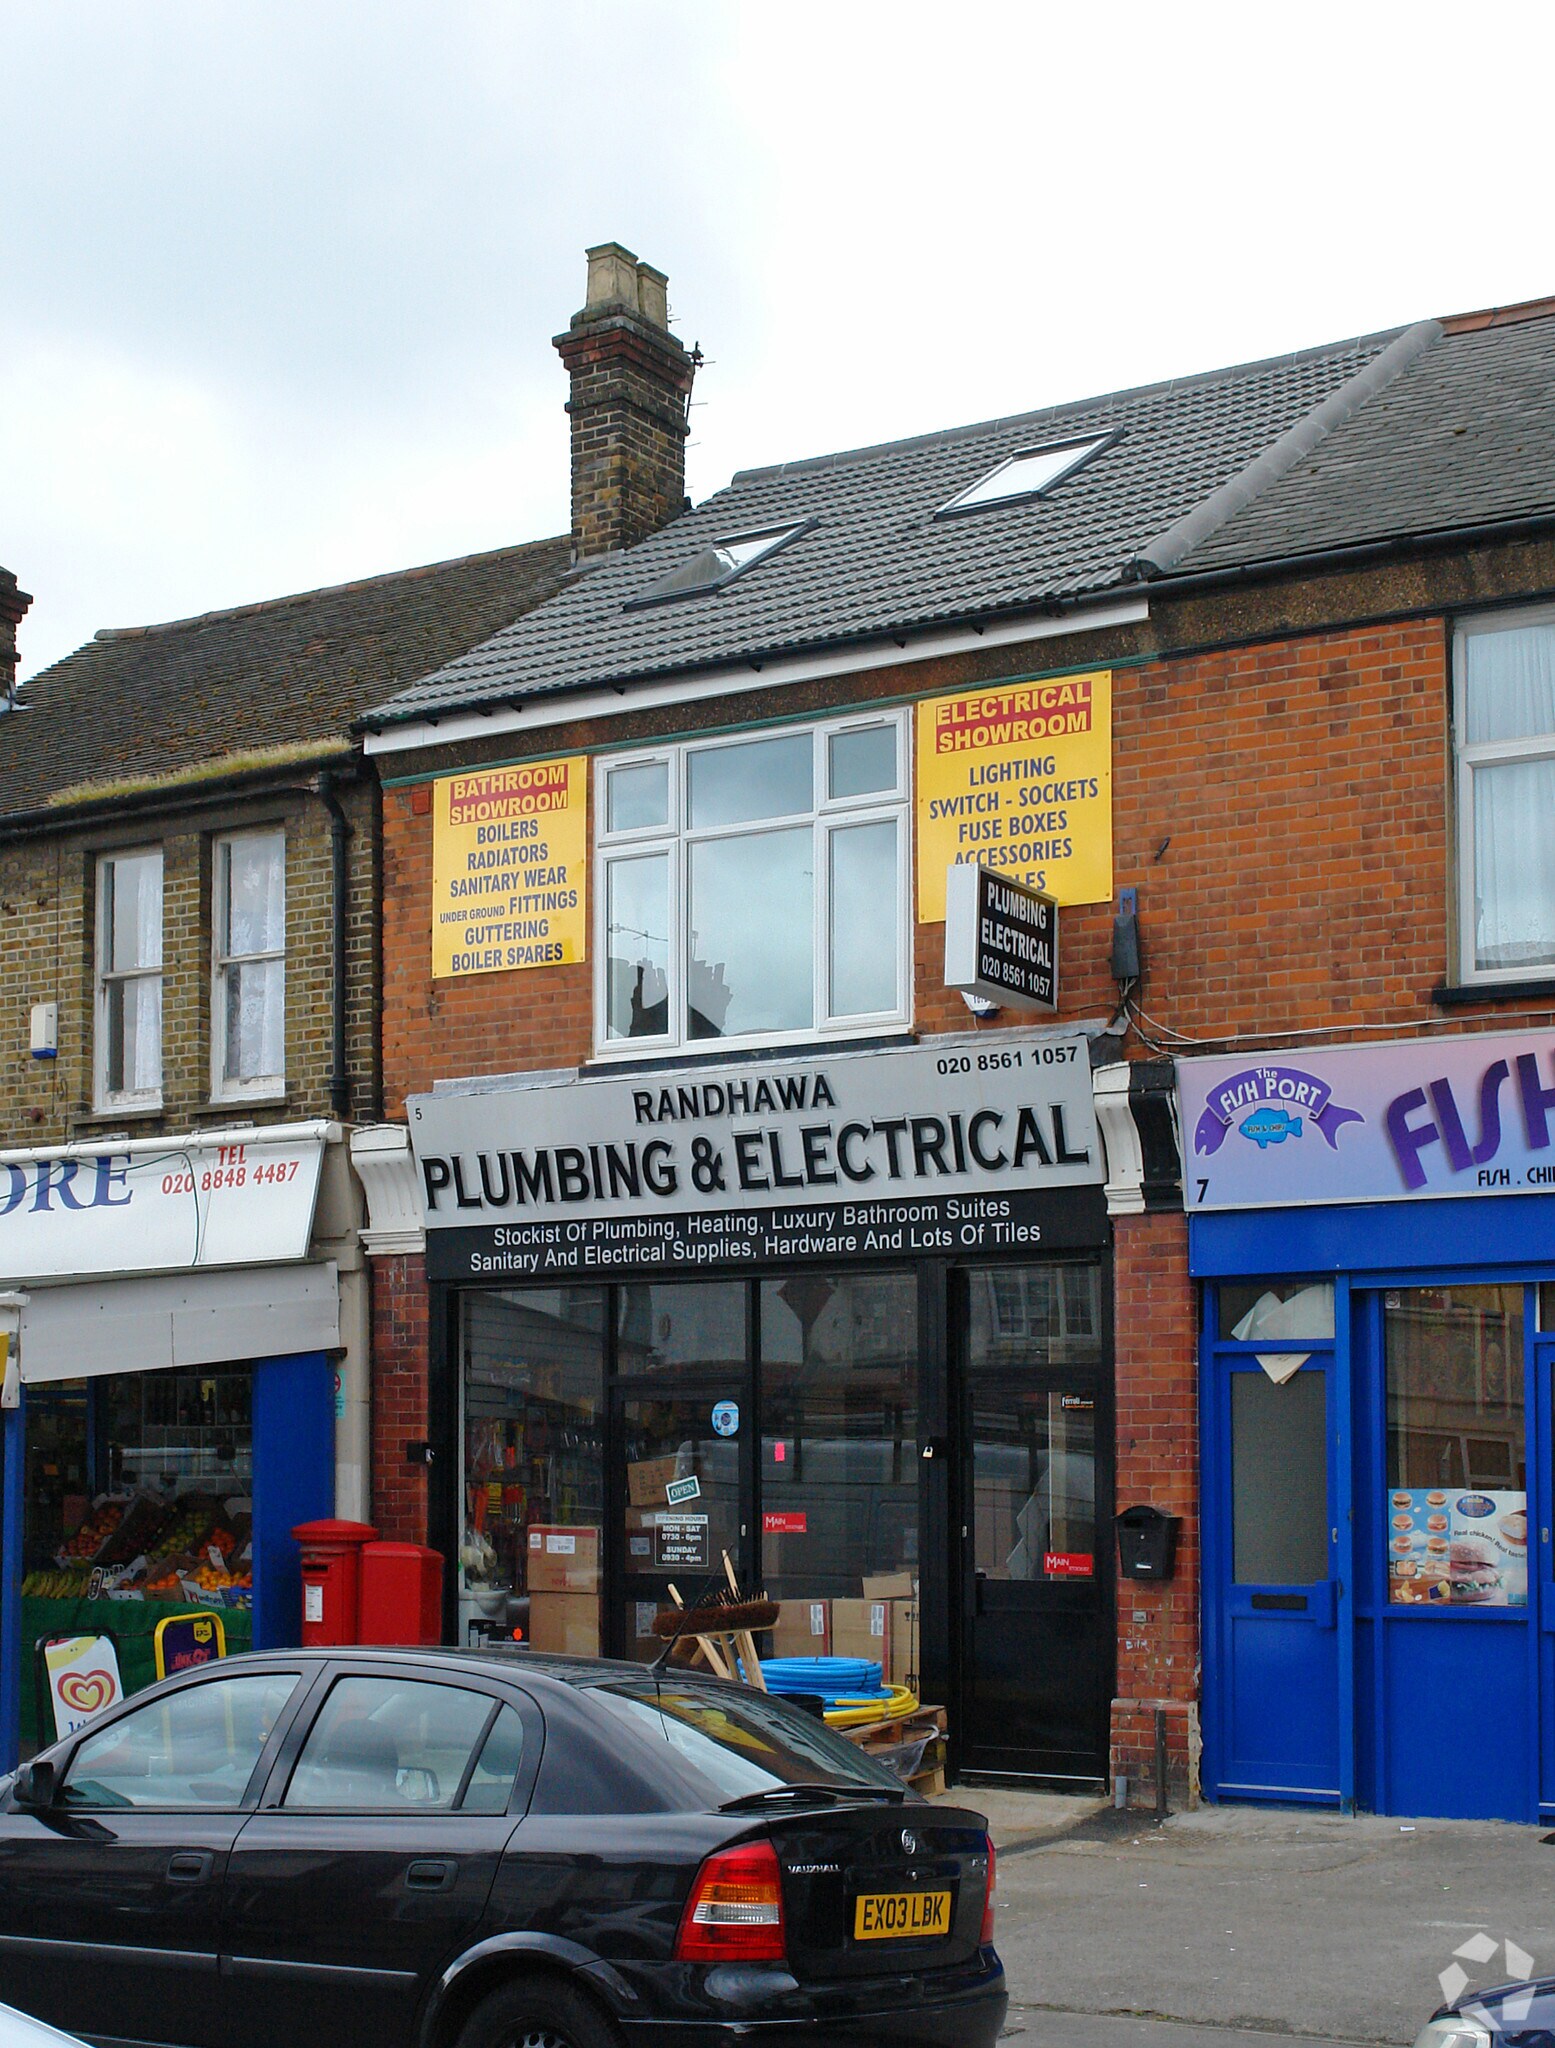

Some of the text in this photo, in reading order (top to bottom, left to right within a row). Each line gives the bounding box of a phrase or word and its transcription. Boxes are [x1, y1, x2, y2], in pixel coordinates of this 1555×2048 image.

[937, 682, 1091, 726] ELECTRICAL
[938, 711, 1088, 753] SHOWROOM
[453, 765, 565, 800] BATHROOM
[969, 755, 1056, 787] LIGHTING
[450, 789, 568, 825] SHOWROOM
[929, 792, 999, 819] SWITCH
[1019, 777, 1099, 808] SOCKETS
[477, 819, 539, 845] BOILERS
[958, 810, 1068, 843] FUSE BOXES
[467, 842, 549, 871] RADIATORS
[954, 837, 1073, 868] ACCESSORIES
[450, 866, 567, 898] SANITARY WEAR
[439, 889, 578, 924] UNDER GROUND FITTINGS
[987, 881, 1047, 930] PLUMBING
[465, 918, 550, 946] GUTTERING
[981, 917, 1052, 969] ELECTRICAL
[452, 942, 564, 972] BOILER SPARES
[982, 954, 1051, 997] 020 8561 1057
[936, 1046, 1078, 1076] 020 8561 1057
[1255, 1068, 1278, 1080] The
[633, 1072, 838, 1125] RANDHAWA
[1220, 1077, 1322, 1114] FISH PORT
[415, 1107, 423, 1121] 5
[217, 1144, 247, 1167] TEL
[421, 1102, 1090, 1211] PLUMBING & ELECTRICAL
[161, 1161, 299, 1195] 020 8848 4487
[1196, 1179, 1210, 1203] 7
[1478, 1168, 1511, 1186] FISH
[1527, 1166, 1555, 1184] CHI
[493, 1198, 1010, 1247] Stockist Of Plumbing, Heating, Luxury Bathroom Suites
[470, 1221, 1041, 1273] Sanitary And Electrical Supplies, Hardware And Lots Of Tiles
[670, 1482, 696, 1498] OPEN
[666, 1546, 697, 1554] SUNDAY
[788, 1863, 841, 1874] VAUXHALL
[863, 1894, 944, 1931] EX03 LBK
